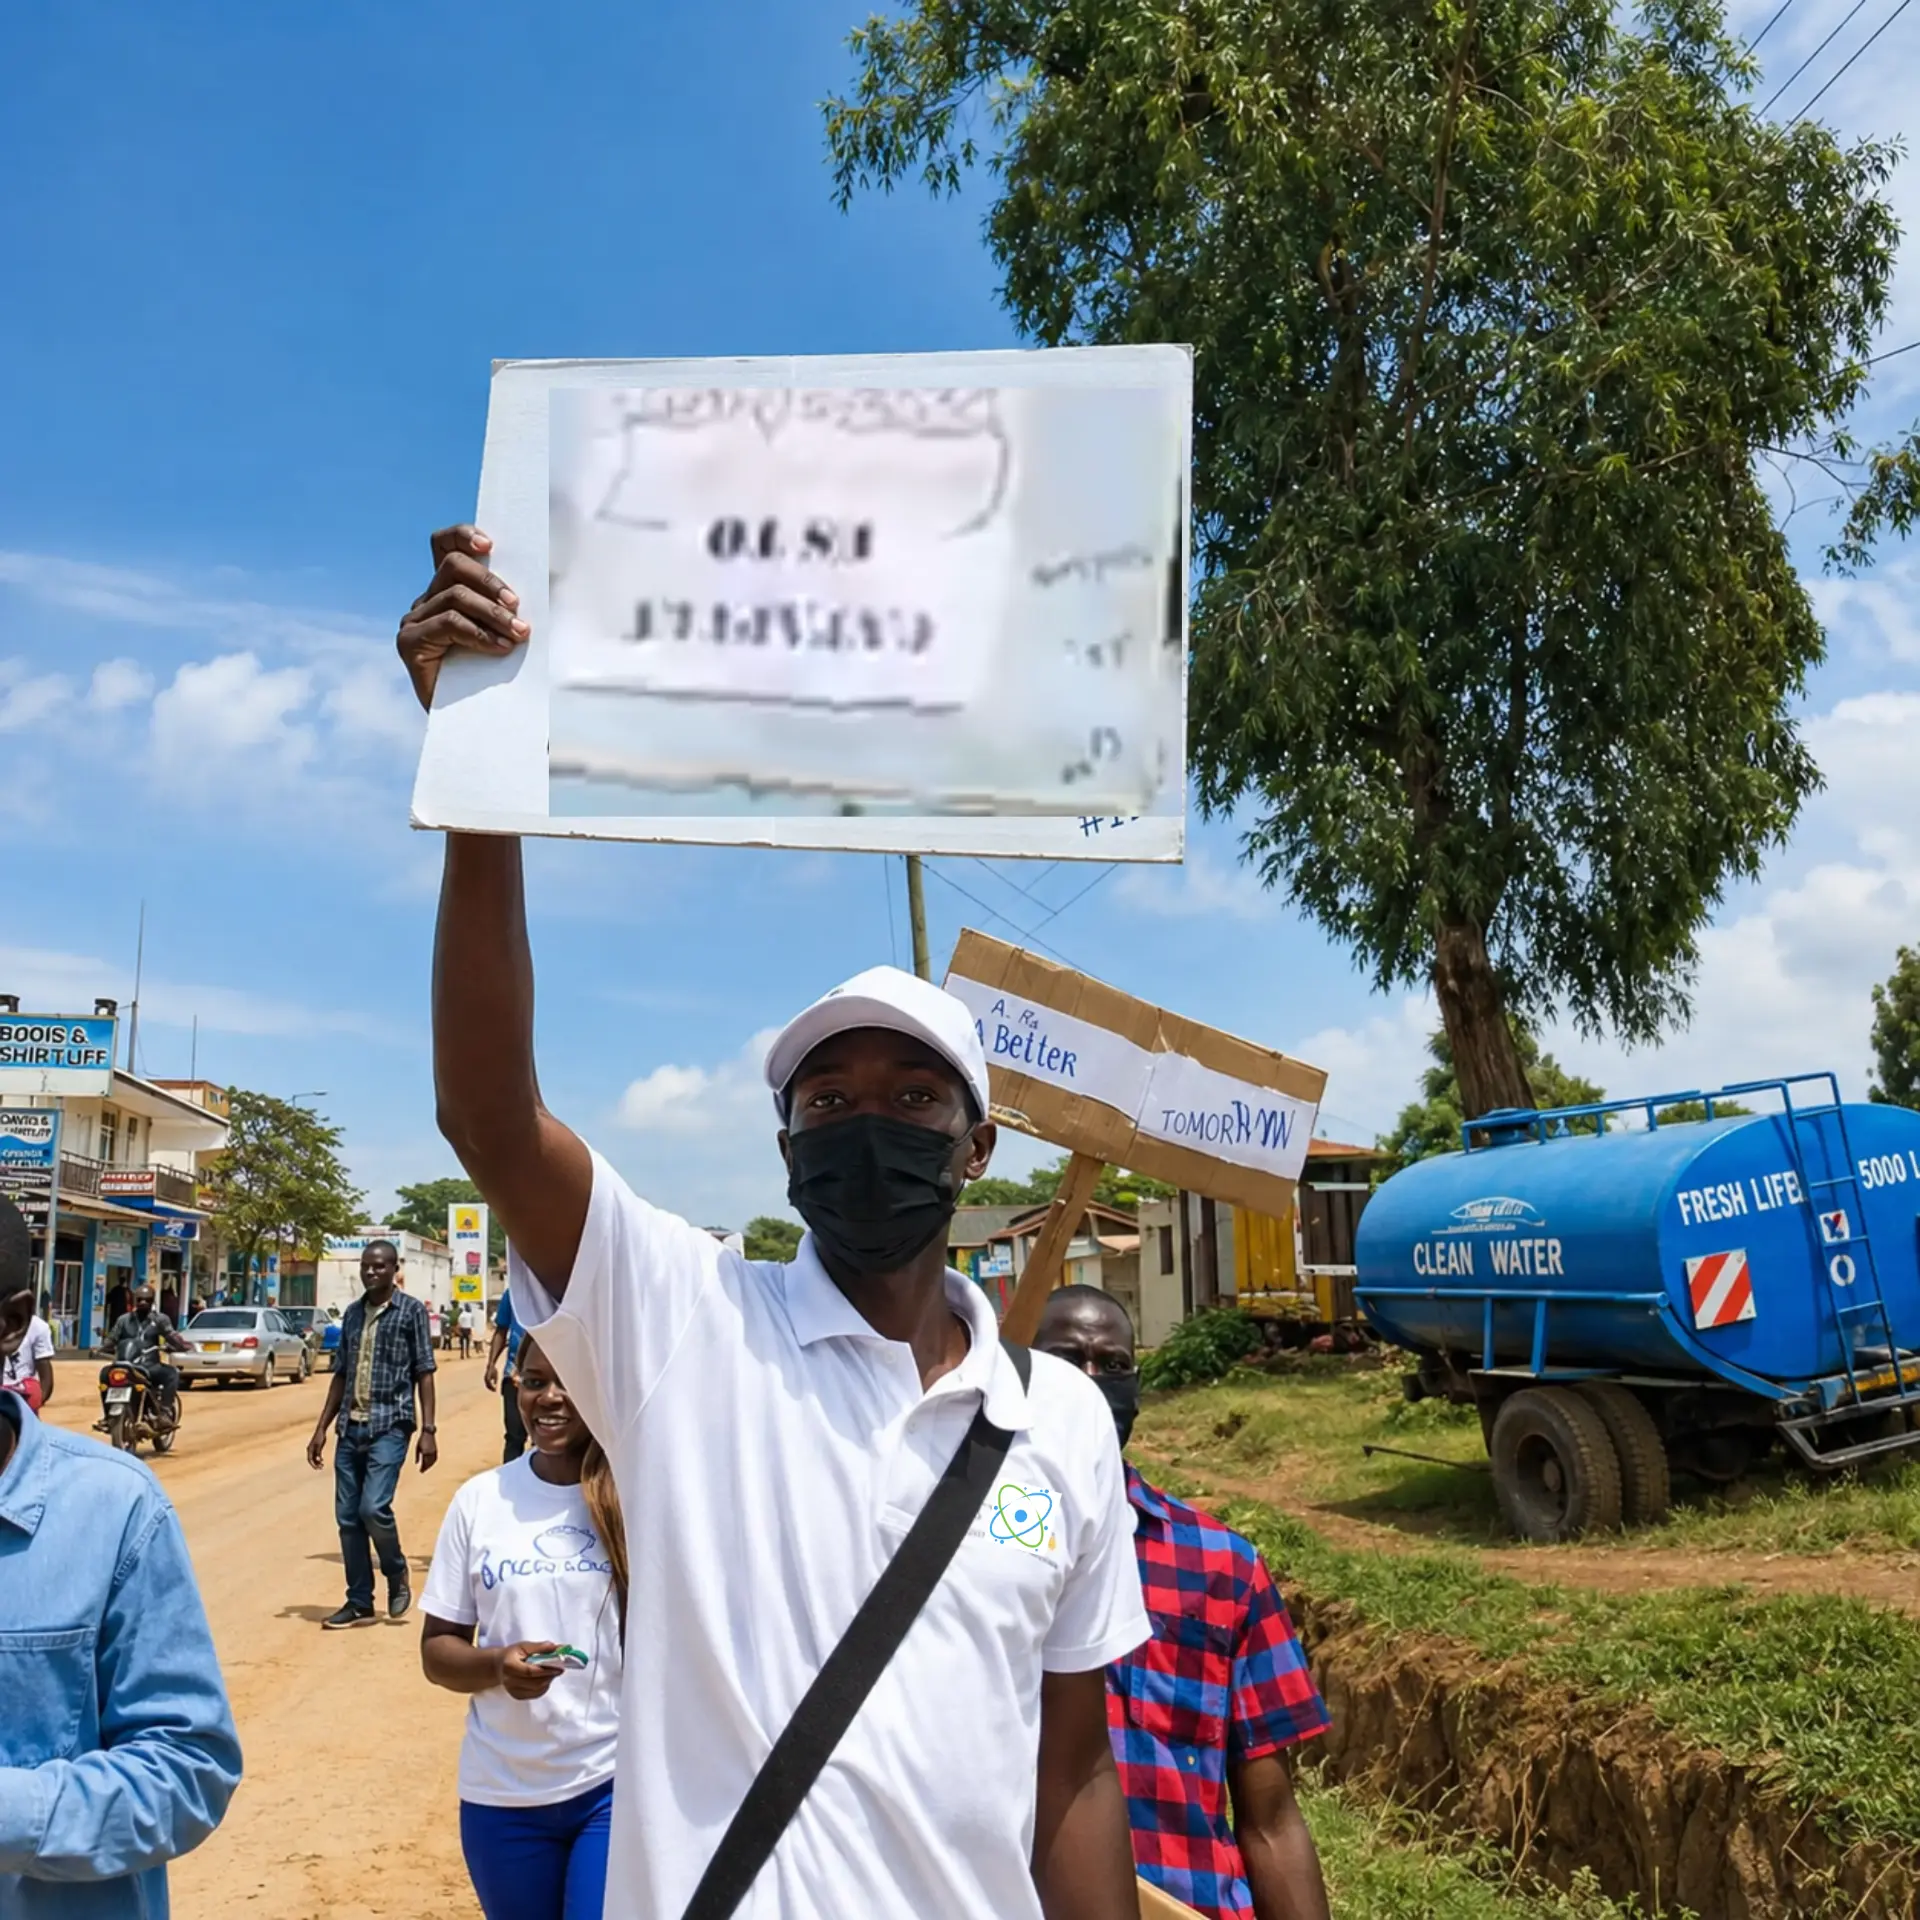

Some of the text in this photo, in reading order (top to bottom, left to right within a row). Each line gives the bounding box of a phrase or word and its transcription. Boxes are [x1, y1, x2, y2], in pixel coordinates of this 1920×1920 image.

[71, 1027, 90, 1044] &
[1857, 1153, 1908, 1191] 5000
[1677, 1180, 1749, 1226] FRESH
[1413, 1238, 1565, 1276] CLEAN WATER
